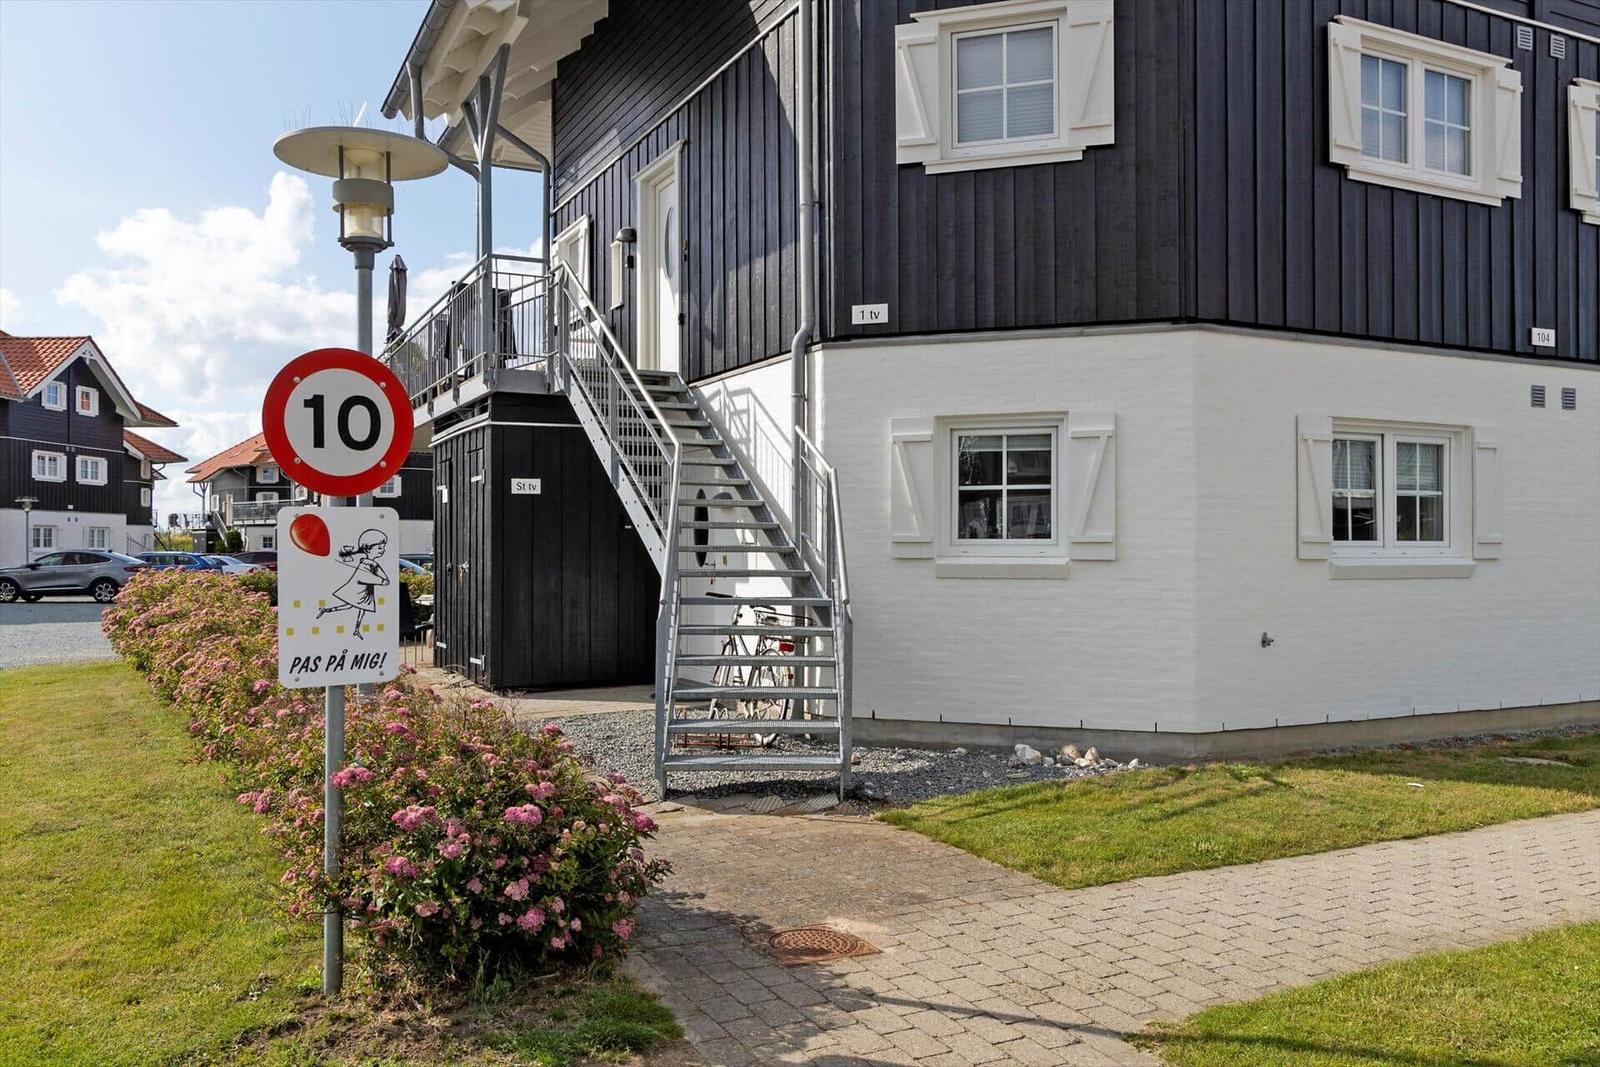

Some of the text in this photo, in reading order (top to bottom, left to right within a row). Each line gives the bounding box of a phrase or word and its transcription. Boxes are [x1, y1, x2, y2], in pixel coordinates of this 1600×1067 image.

[859, 310, 880, 320] 1 tv
[1536, 332, 1550, 343] 104
[303, 394, 382, 451] 10
[516, 481, 526, 491] St
[289, 649, 387, 674] PAS PÅ MIG!
